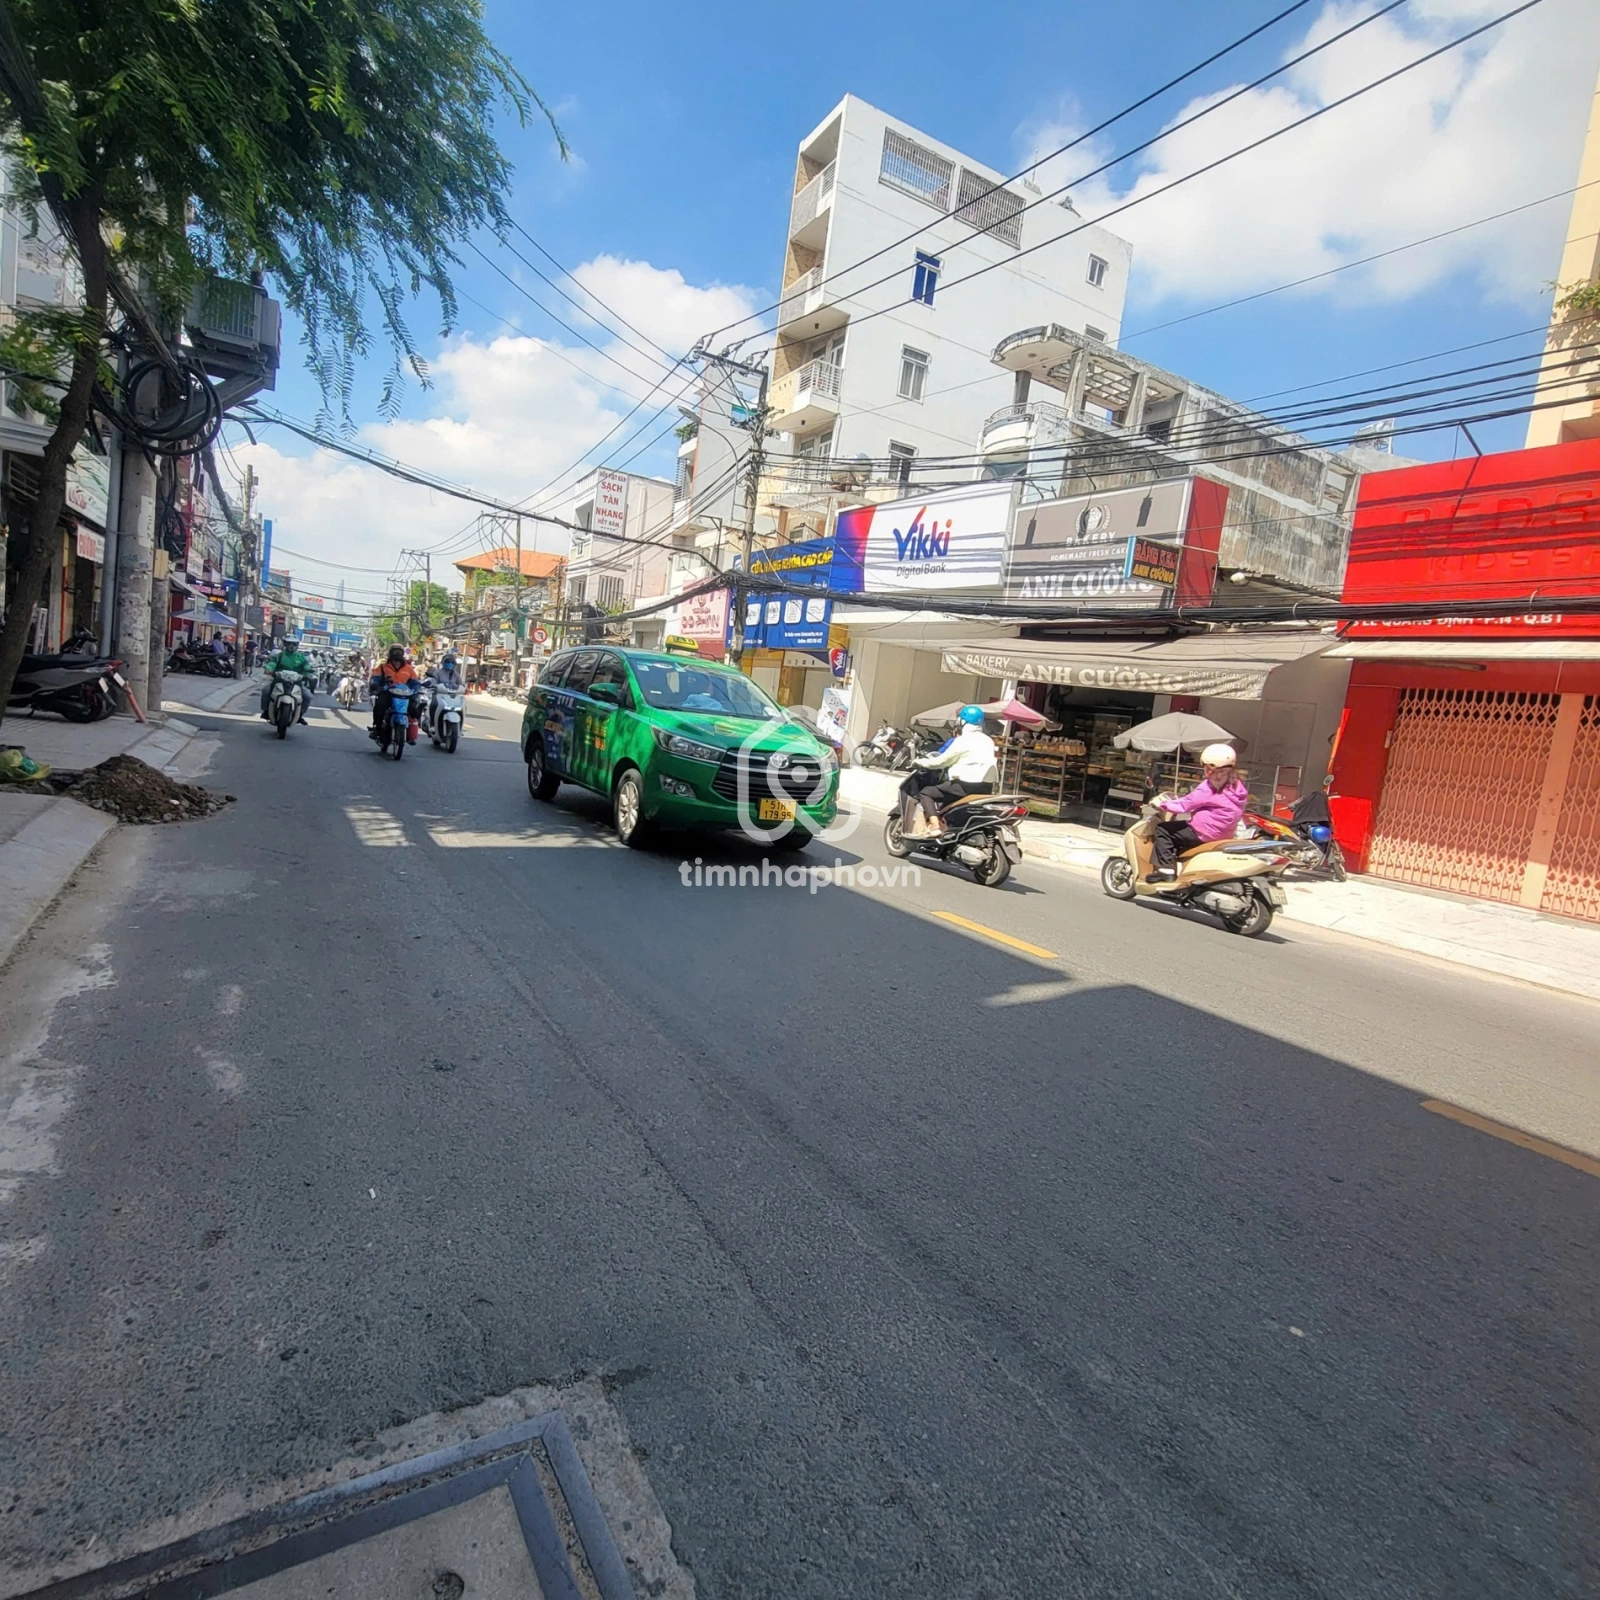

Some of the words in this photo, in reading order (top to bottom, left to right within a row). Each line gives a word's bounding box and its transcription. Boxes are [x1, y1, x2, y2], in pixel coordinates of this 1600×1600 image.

[601, 481, 623, 493] SẠCH
[602, 494, 620, 506] TÀN
[595, 507, 624, 520] NHANG
[893, 505, 952, 561] Vikki
[1065, 531, 1116, 546] BAKERY
[802, 553, 817, 567] CAO
[1050, 551, 1087, 562] HOMEMADE
[1088, 549, 1110, 558] FRESH
[1132, 563, 1150, 577] ANH
[1018, 574, 1065, 599] ANH
[966, 654, 1011, 668] BAKERY
[1018, 663, 1072, 683] ANH
[1078, 665, 1185, 692] CƯỜNG
